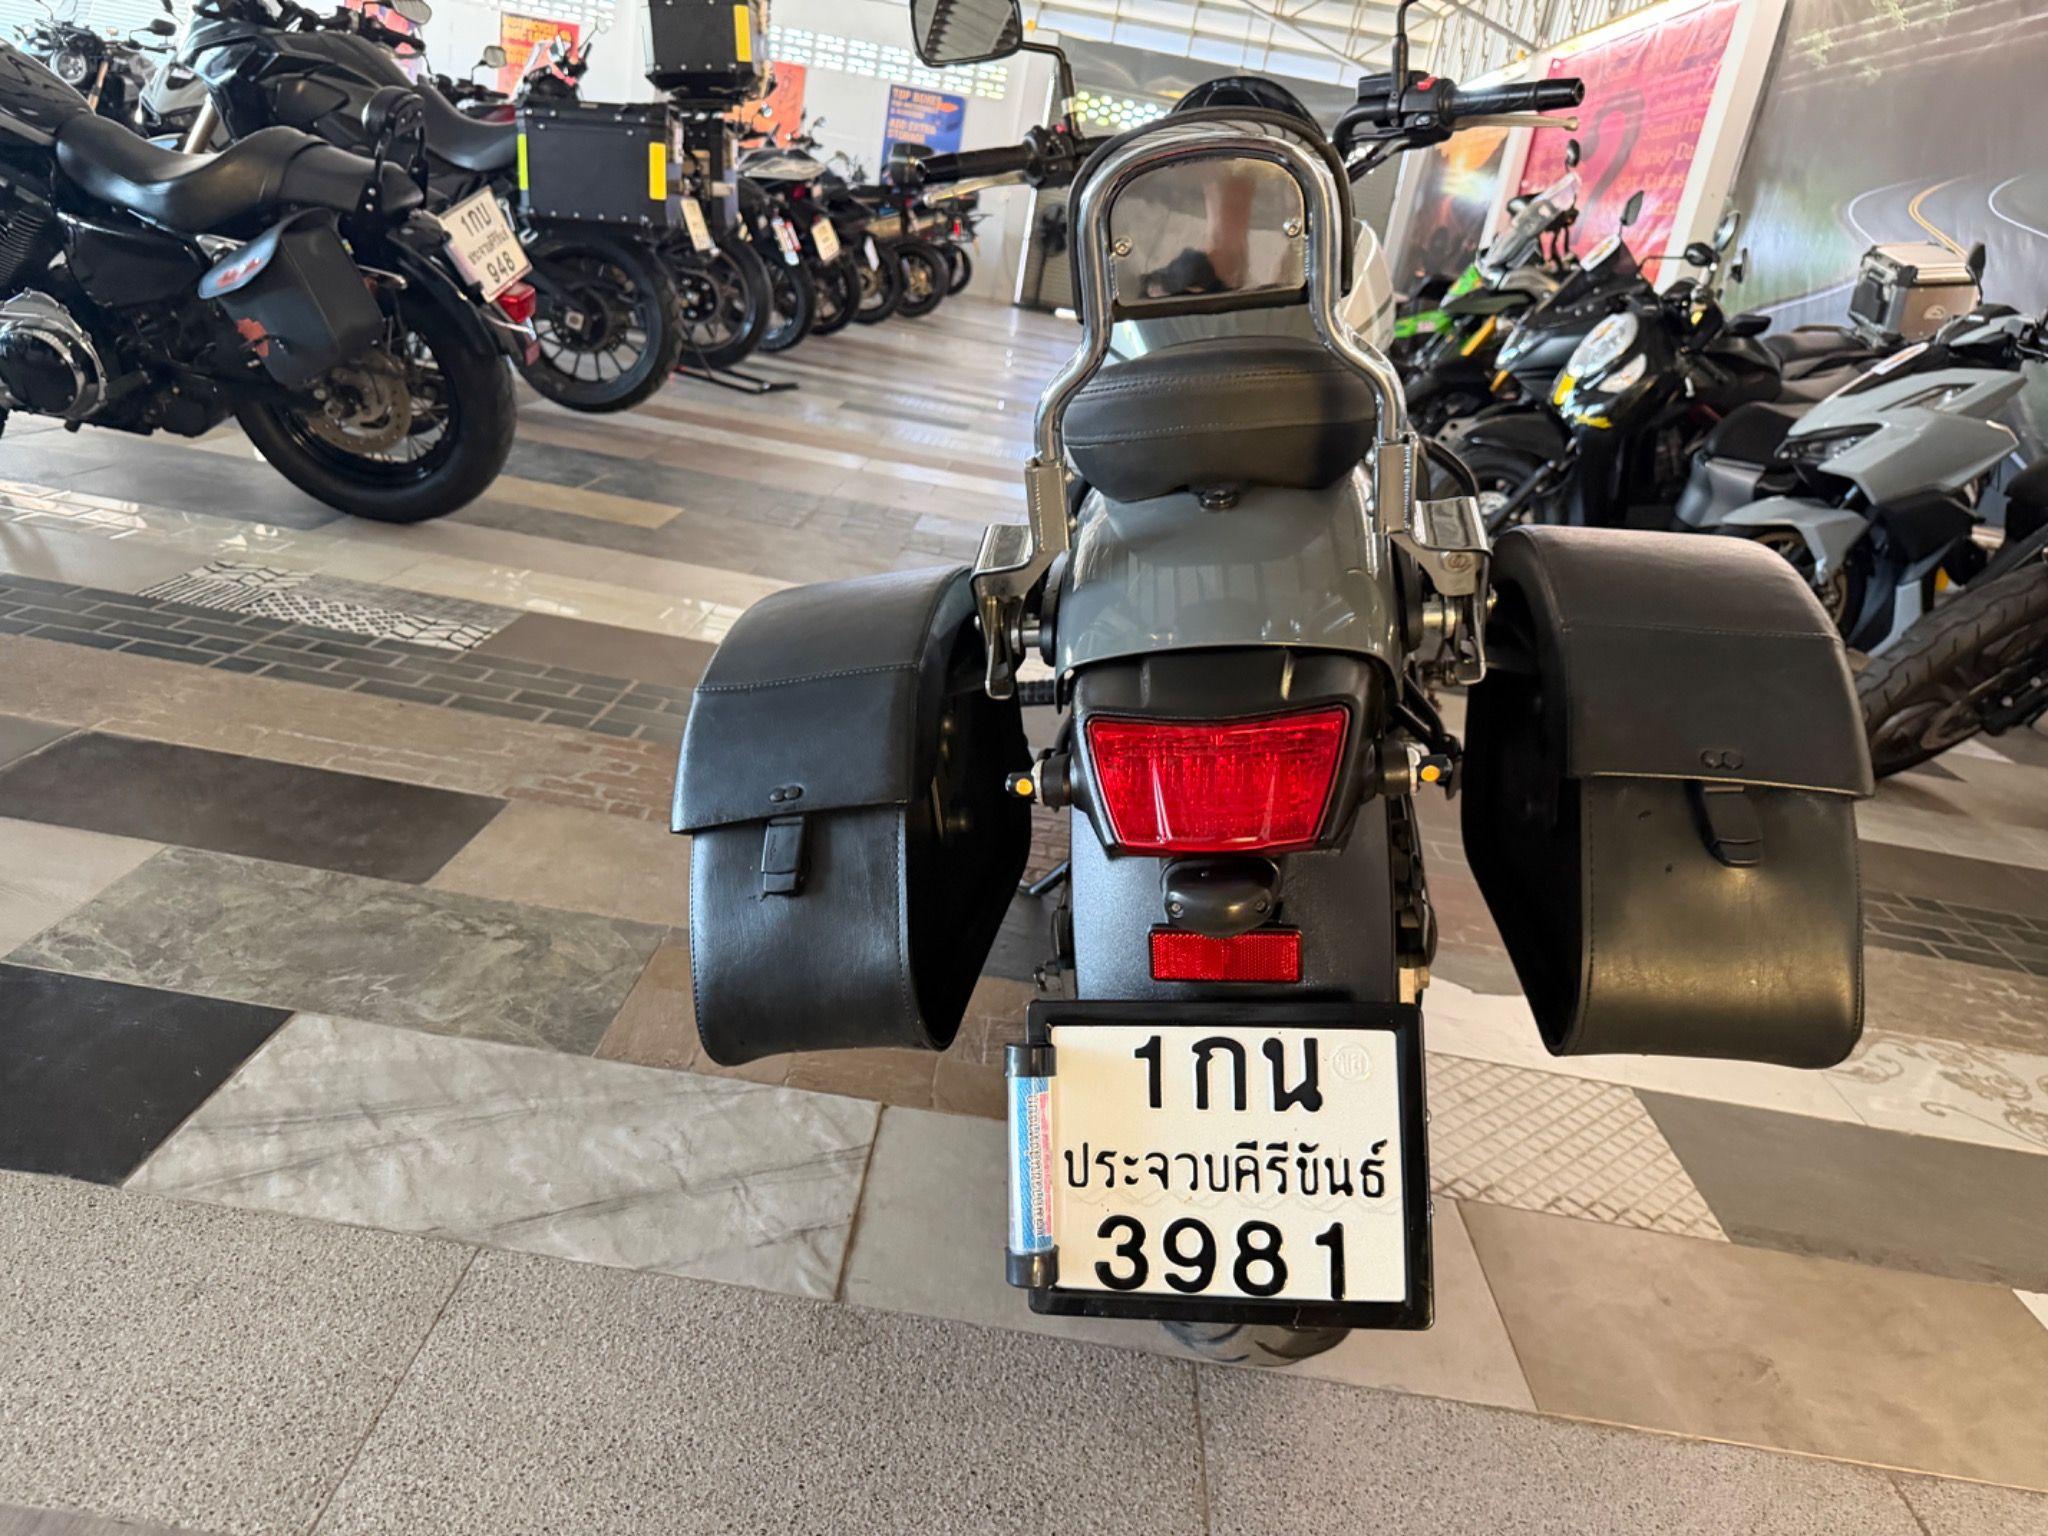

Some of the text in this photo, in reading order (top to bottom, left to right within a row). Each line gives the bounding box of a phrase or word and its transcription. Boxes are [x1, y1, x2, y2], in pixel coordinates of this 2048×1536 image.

[486, 251, 515, 284] 948
[1134, 1035, 1323, 1113] 1กน
[1064, 1139, 1388, 1198] ประจวบคีรีขันธ์
[1094, 1214, 1345, 1300] 3981
